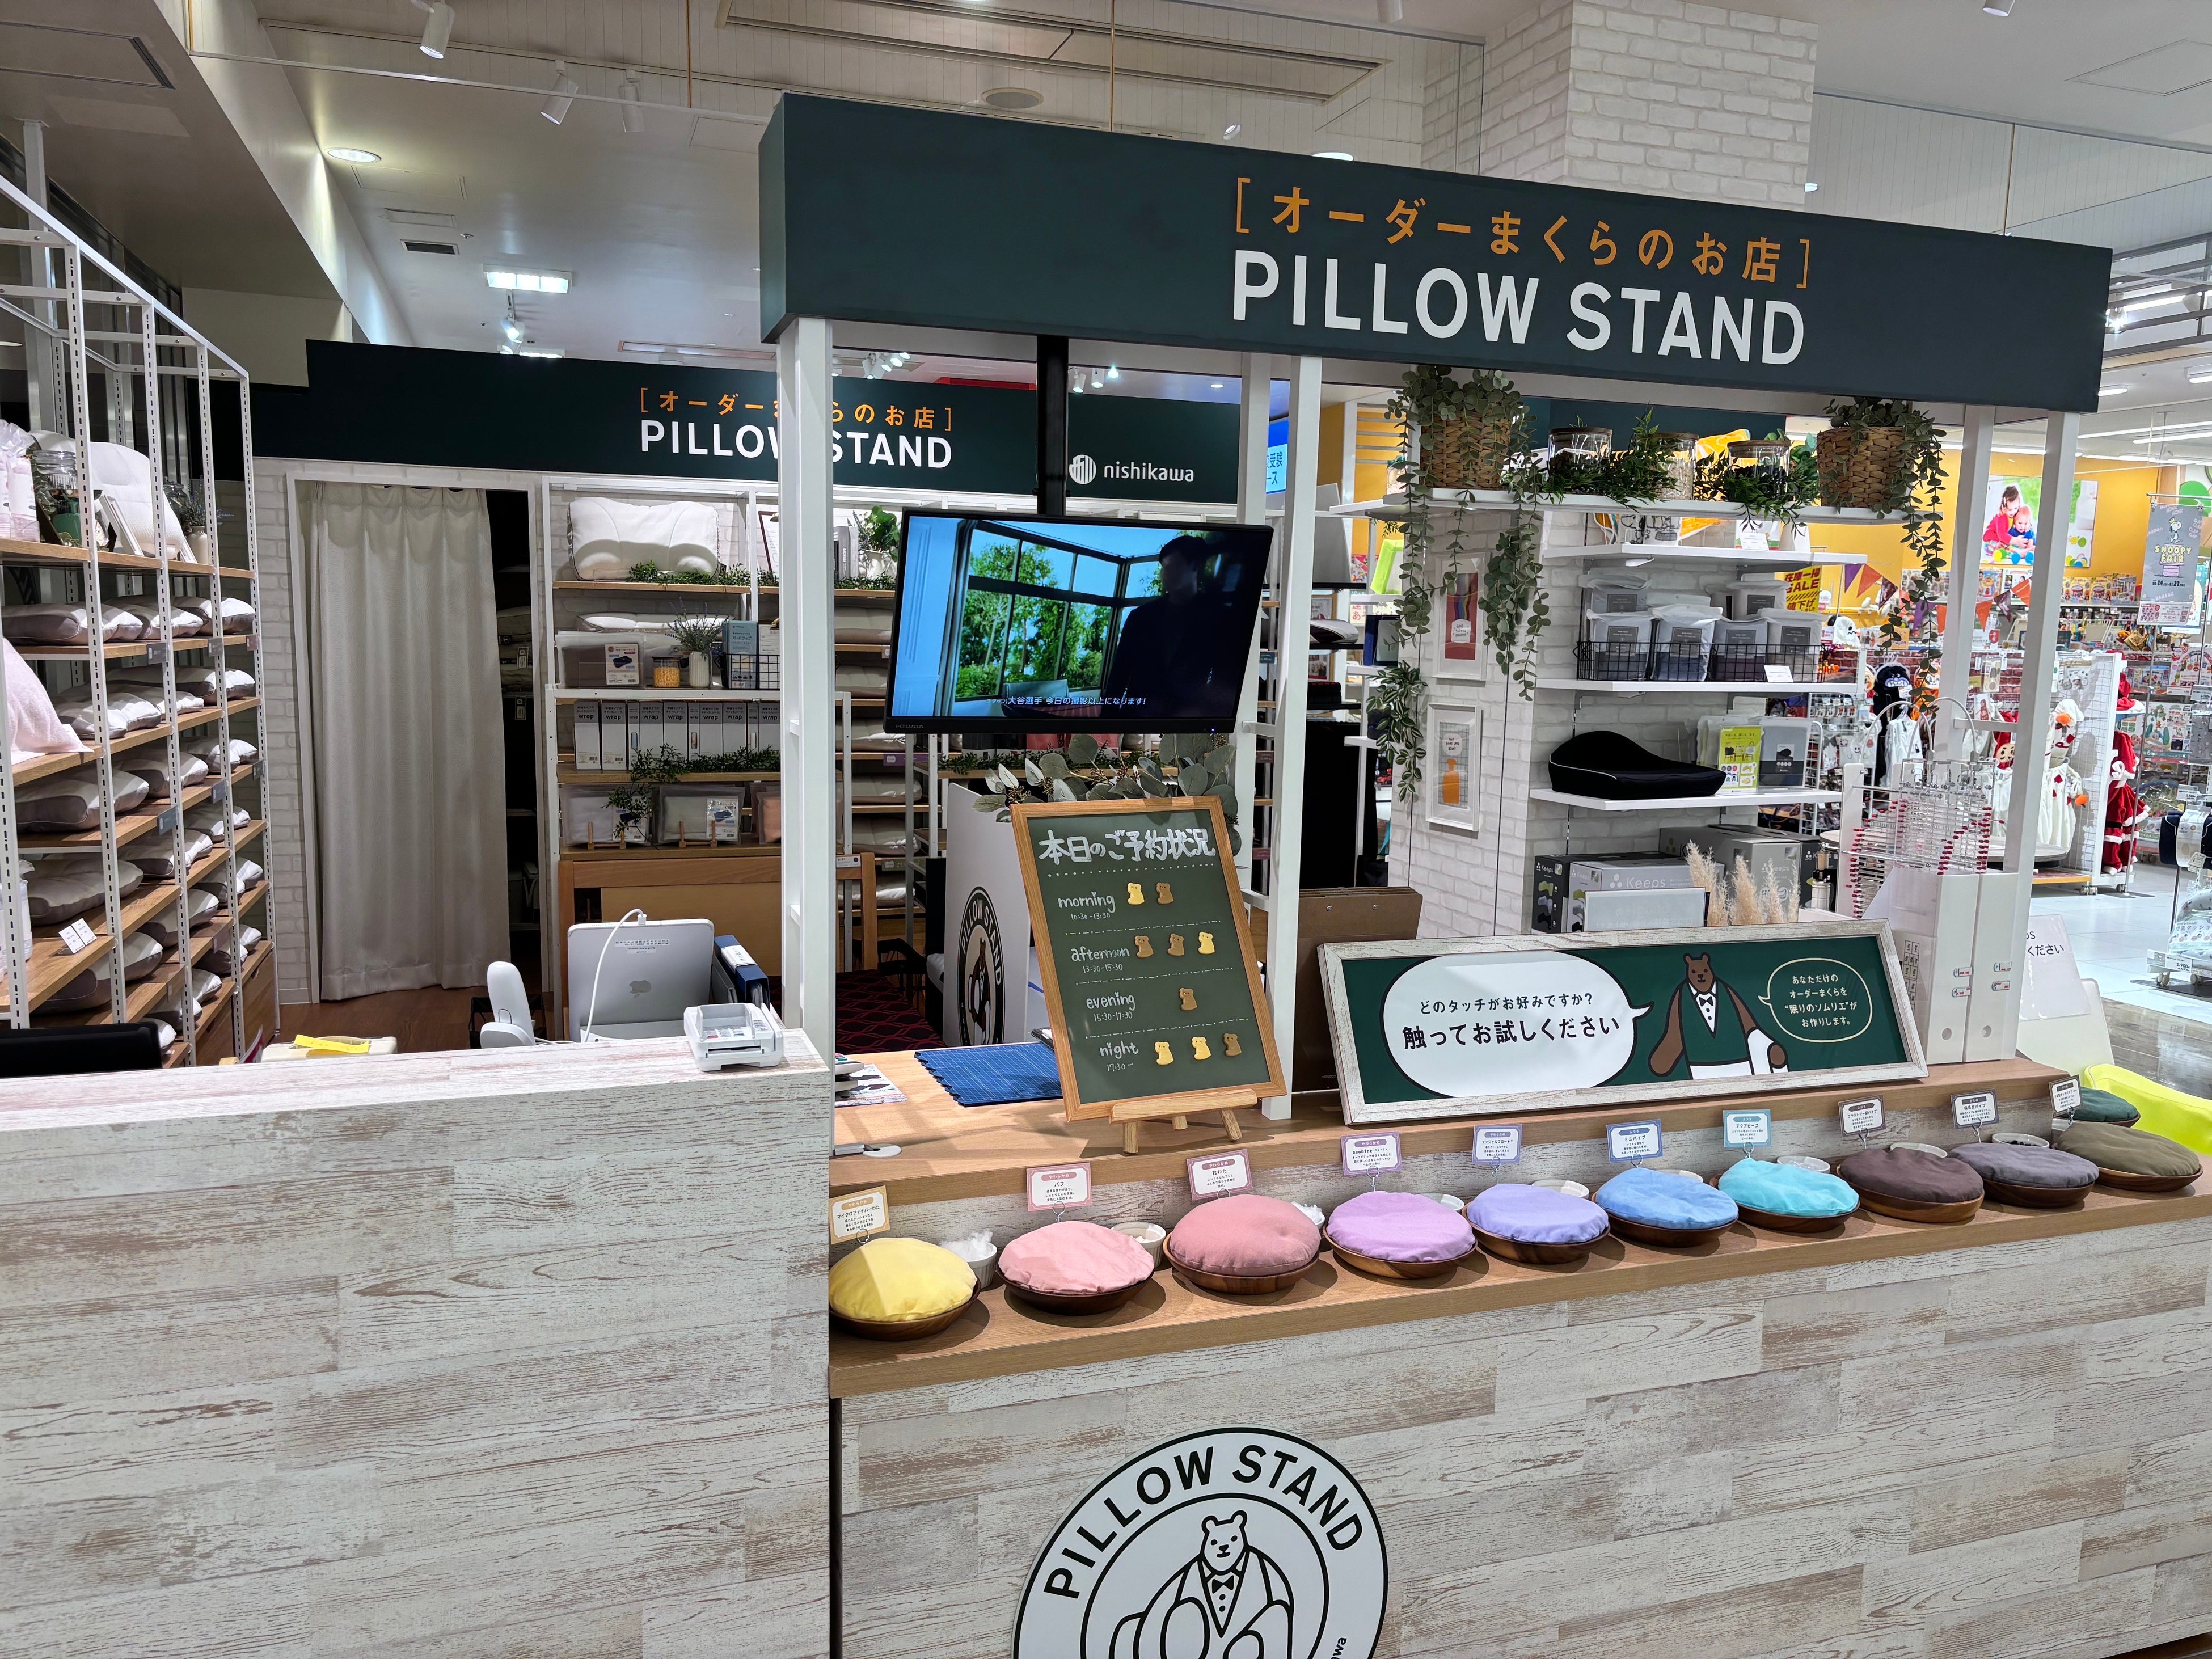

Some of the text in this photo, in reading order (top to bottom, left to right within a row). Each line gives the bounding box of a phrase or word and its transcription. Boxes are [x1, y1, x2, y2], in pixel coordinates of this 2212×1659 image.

[1234, 250, 1804, 365] PILLOW STAND
[640, 387, 951, 432] [オーダーらのお店]
[641, 420, 951, 468] PILLO STAND
[1104, 461, 1194, 482] nishikawa
[2155, 544, 2192, 555] SNOOPY
[2160, 554, 2184, 563] FAIR
[1785, 579, 1820, 593] SALE
[1787, 598, 1816, 611] 値下げ
[1039, 829, 1216, 864] 本日のご予約状況
[1541, 864, 1553, 873] Keeps
[1627, 877, 1666, 888] Keeps
[1058, 891, 1116, 913] morning
[961, 898, 1001, 986] PILLOW STAND
[1070, 946, 1130, 962] afternoon
[1792, 974, 1838, 985] あなただけの
[1086, 991, 1135, 1011] evening
[1789, 987, 1847, 999] オーダーまくらを
[1801, 1016, 1850, 1027] お作りします。
[1402, 1016, 1620, 1050] 触ってお試しください
[1100, 1041, 1139, 1059] night
[837, 1205, 880, 1219] マイクロファイバーわた
[1044, 1445, 1362, 1599] PILLOW STAND
